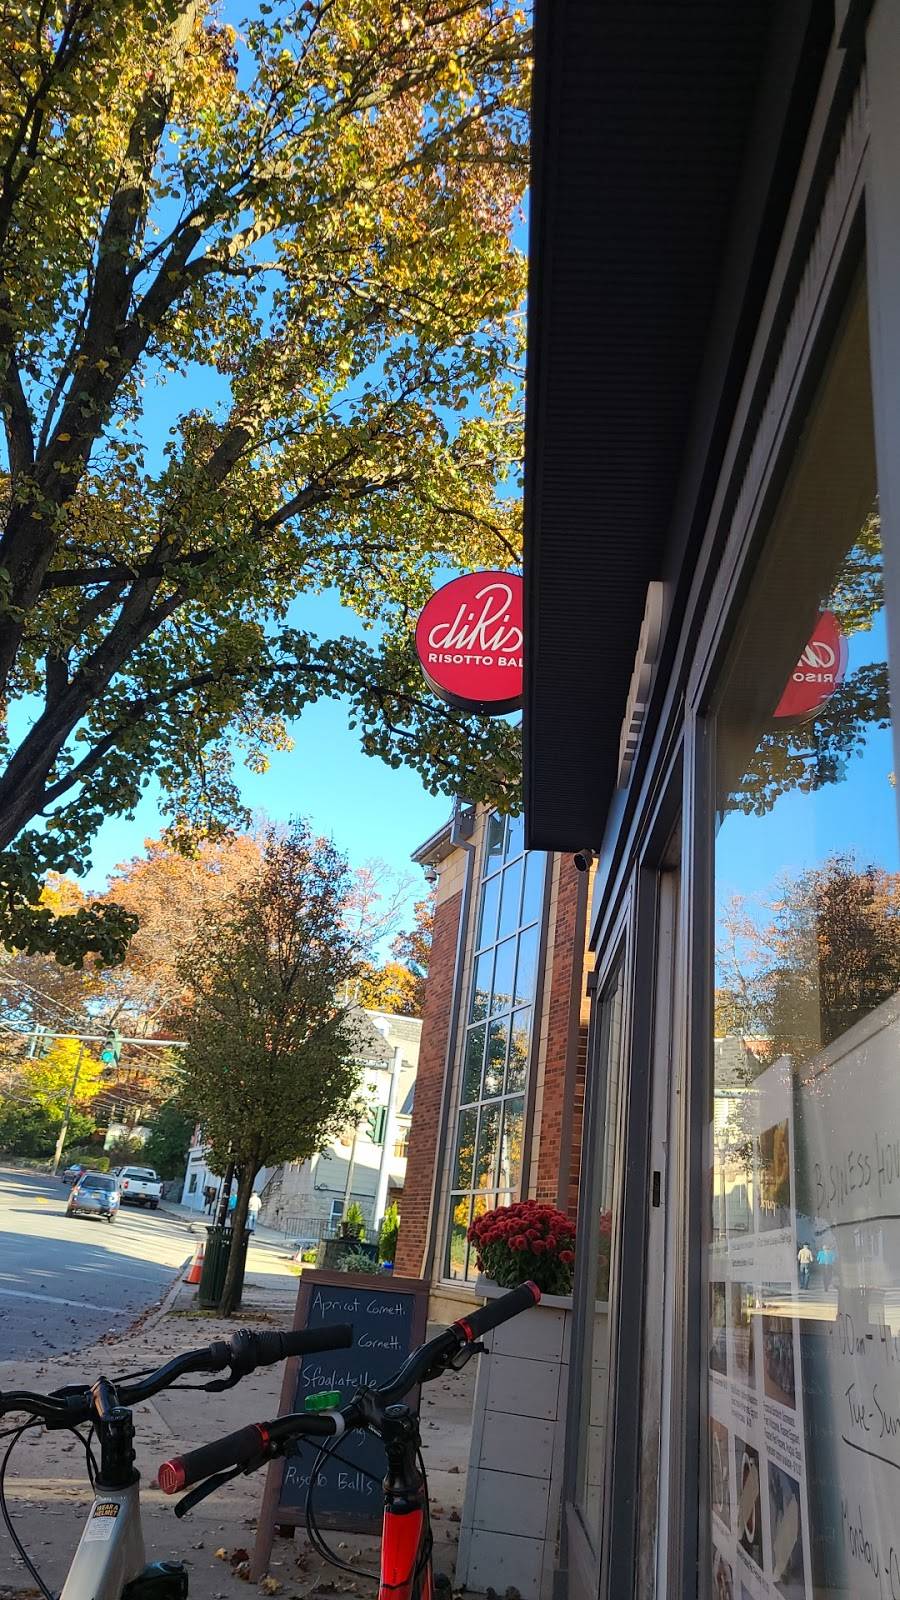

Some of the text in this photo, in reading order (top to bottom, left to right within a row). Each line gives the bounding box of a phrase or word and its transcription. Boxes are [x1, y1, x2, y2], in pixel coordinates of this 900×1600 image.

[428, 653, 493, 665] RISOTTO
[312, 1291, 361, 1319] Apricot
[284, 1466, 328, 1489] Risoto
